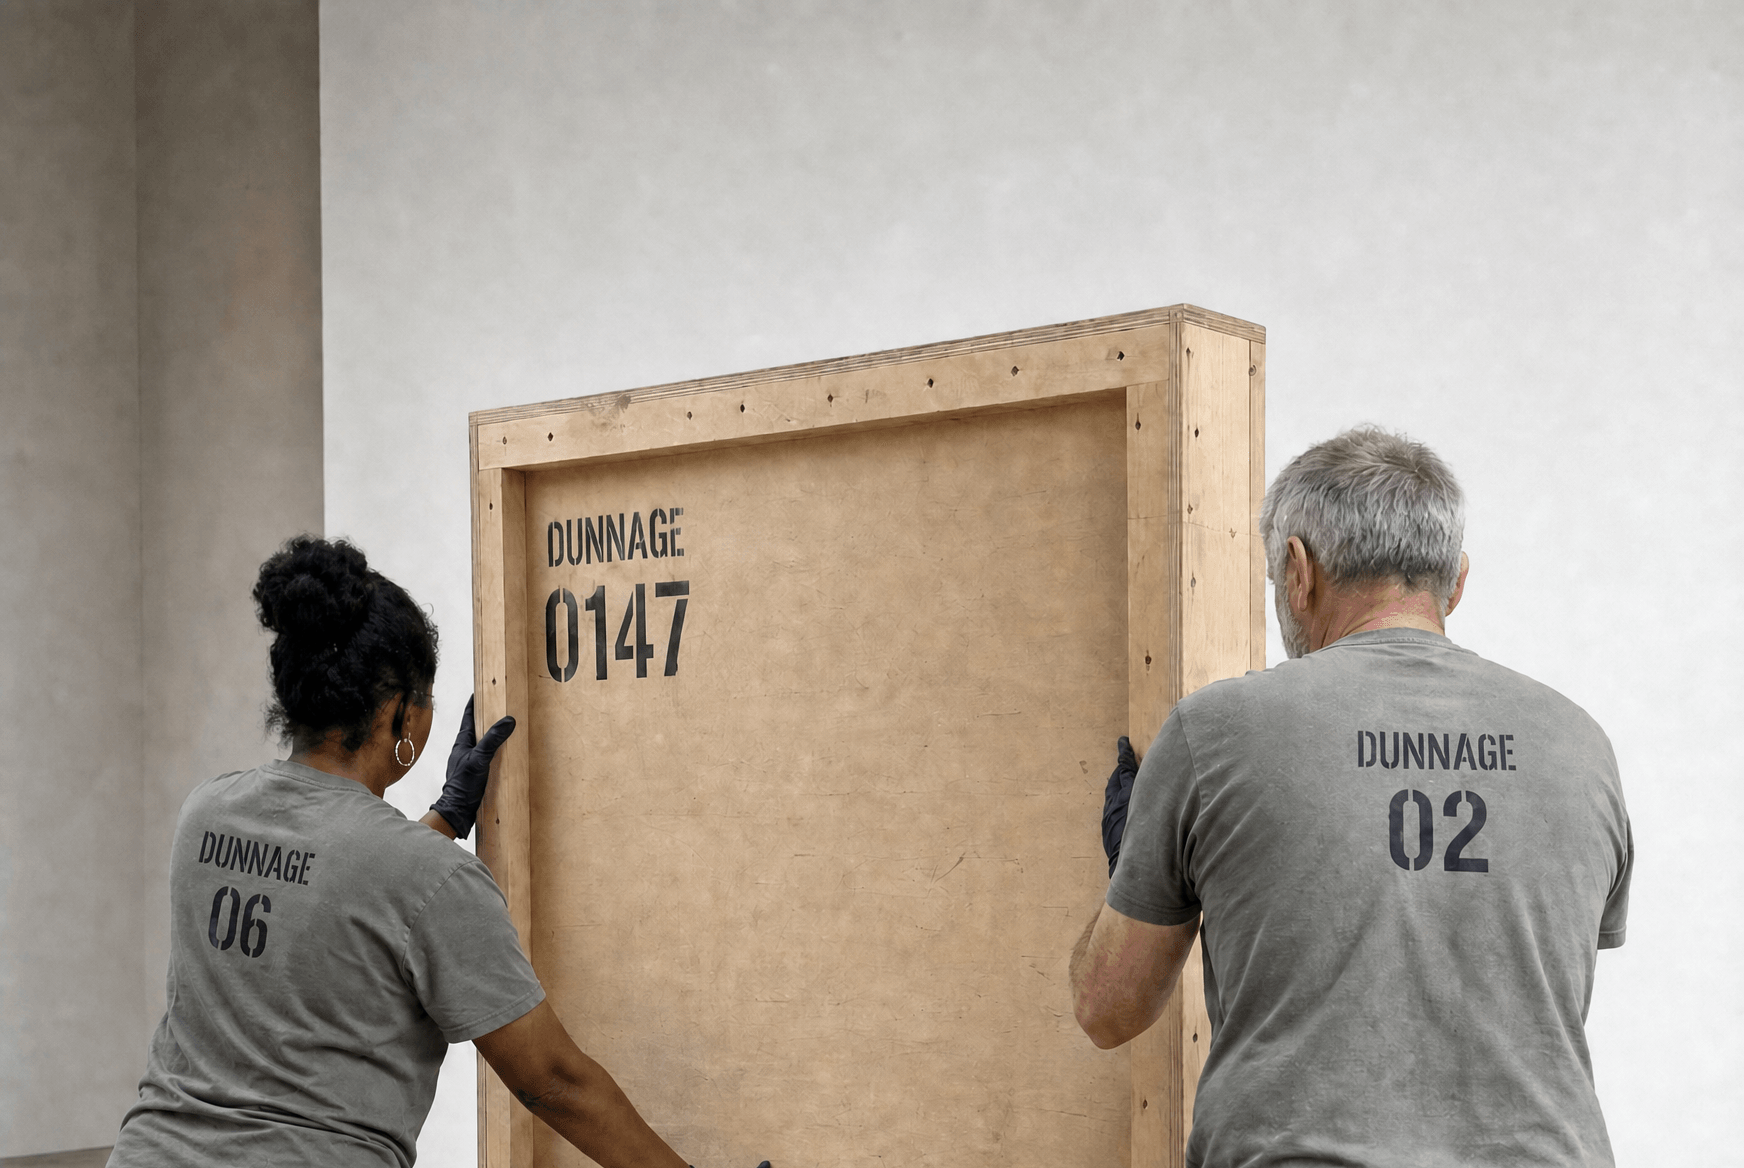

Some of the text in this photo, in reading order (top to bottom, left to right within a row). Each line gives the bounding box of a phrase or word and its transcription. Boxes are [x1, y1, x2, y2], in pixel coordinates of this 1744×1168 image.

[547, 507, 684, 567] DUNNAGE
[545, 580, 690, 683] 0147
[1357, 730, 1517, 771] DUNNAGE
[198, 830, 316, 886] DUNNAGE
[1388, 788, 1489, 873] 02
[208, 885, 272, 959] 06
